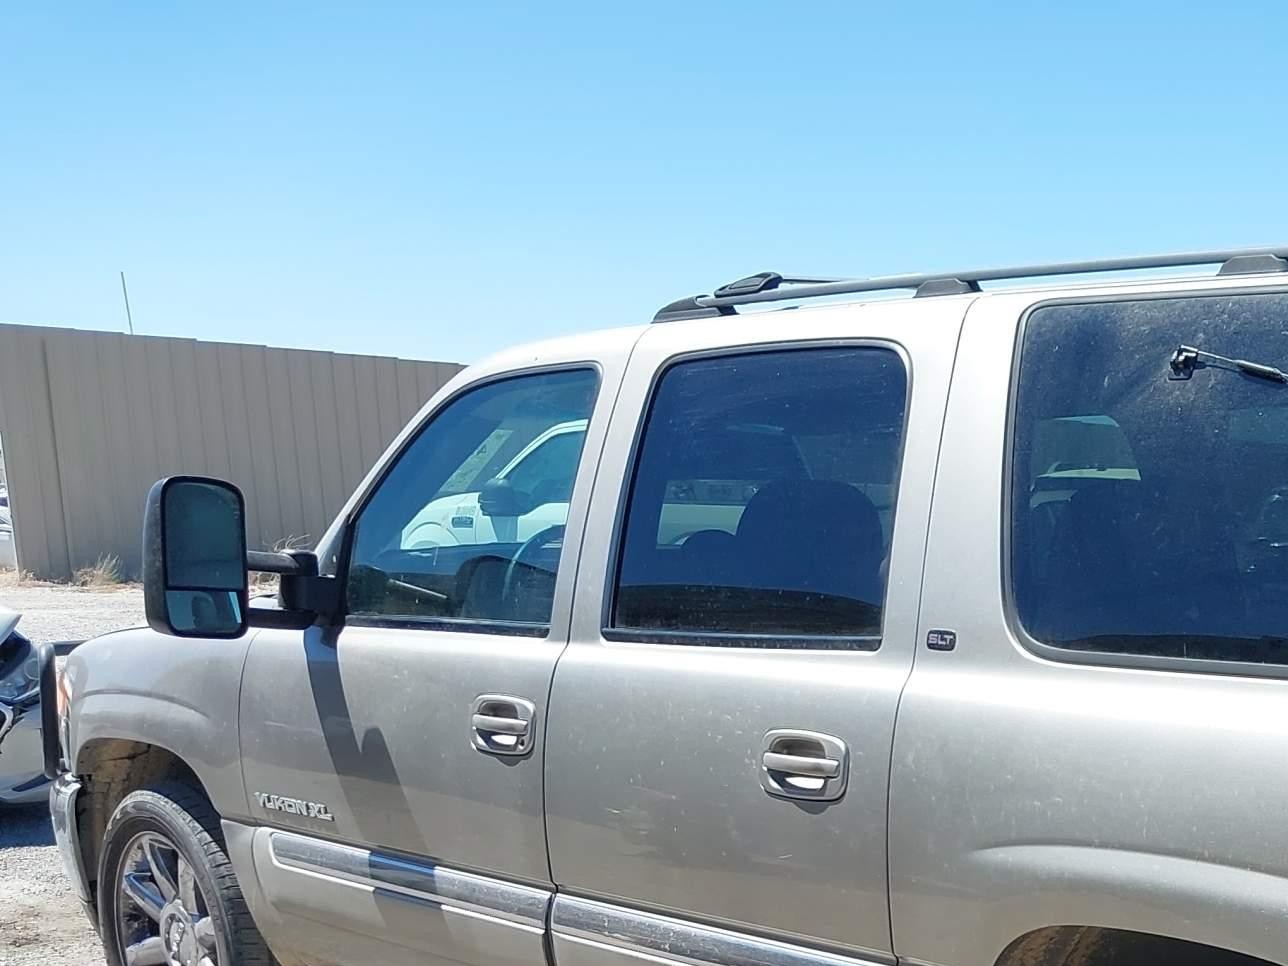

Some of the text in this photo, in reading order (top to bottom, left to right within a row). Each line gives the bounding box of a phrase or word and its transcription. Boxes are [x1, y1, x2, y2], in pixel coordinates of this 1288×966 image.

[928, 633, 954, 645] SLT
[254, 792, 335, 821] YUKON XL
